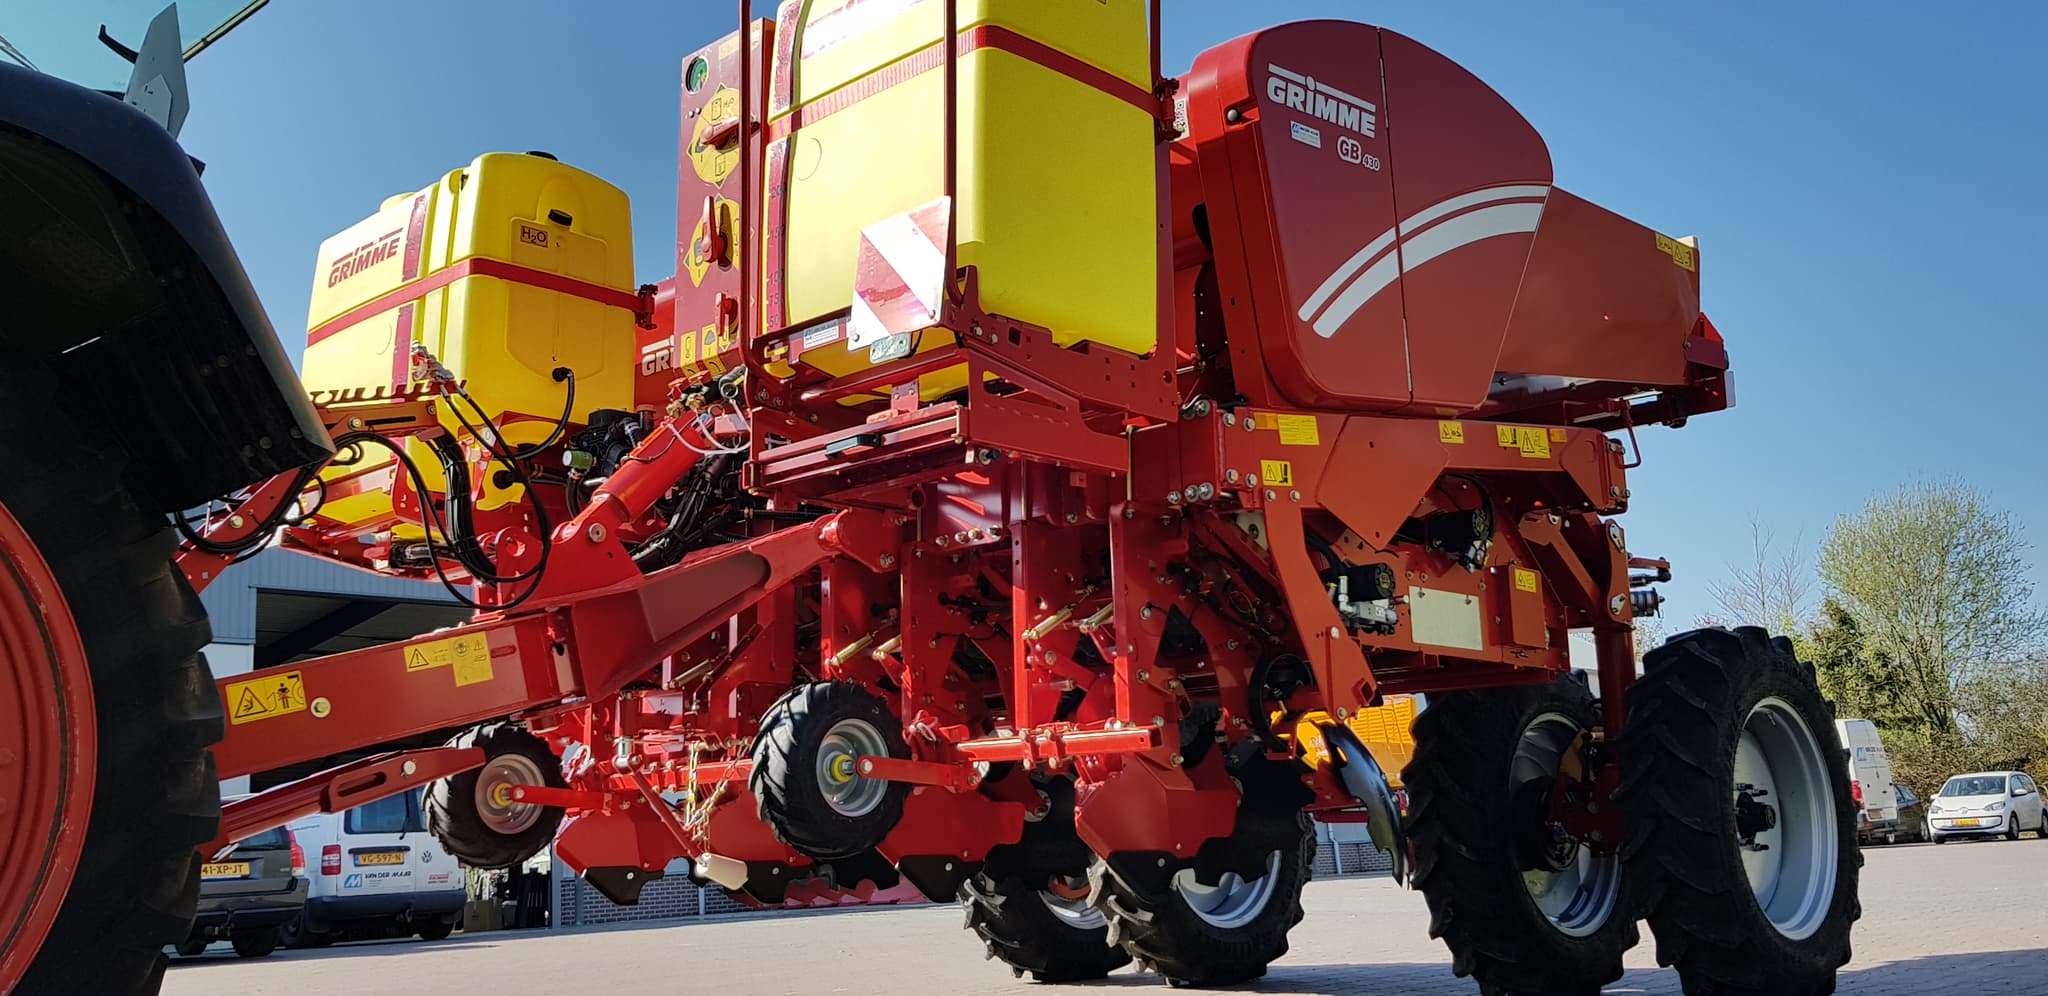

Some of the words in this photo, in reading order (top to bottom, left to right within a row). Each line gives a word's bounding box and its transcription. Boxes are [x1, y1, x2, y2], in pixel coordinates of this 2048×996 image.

[1267, 76, 1376, 138] GRIMME
[1339, 138, 1360, 162] GB
[1362, 154, 1380, 170] 430
[328, 237, 401, 288] GRIMME
[203, 864, 243, 875] 41-XP-JT
